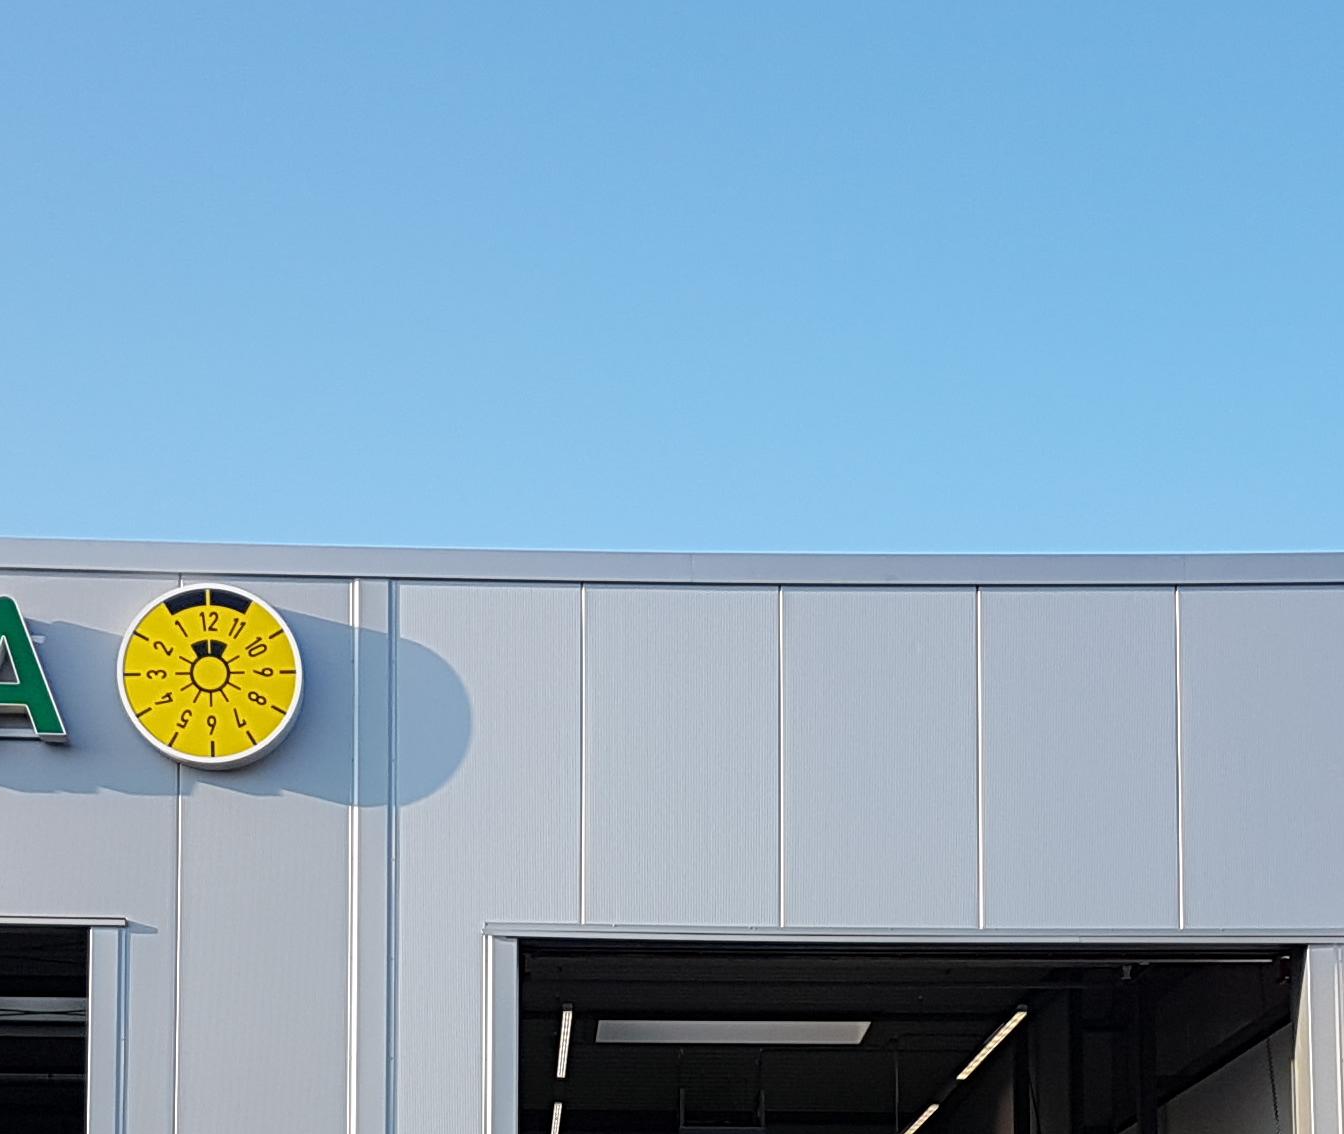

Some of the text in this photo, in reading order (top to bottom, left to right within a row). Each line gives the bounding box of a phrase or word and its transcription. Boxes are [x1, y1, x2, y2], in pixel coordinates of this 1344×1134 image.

[175, 620, 188, 638] 1
[200, 612, 219, 632] 12
[228, 618, 246, 639] 11
[153, 640, 174, 656] 2
[245, 637, 268, 658] 10
[146, 669, 167, 680] 3
[154, 692, 174, 705] 4
[247, 691, 267, 706] 8
[177, 709, 192, 729] 5
[233, 708, 247, 728] 7
